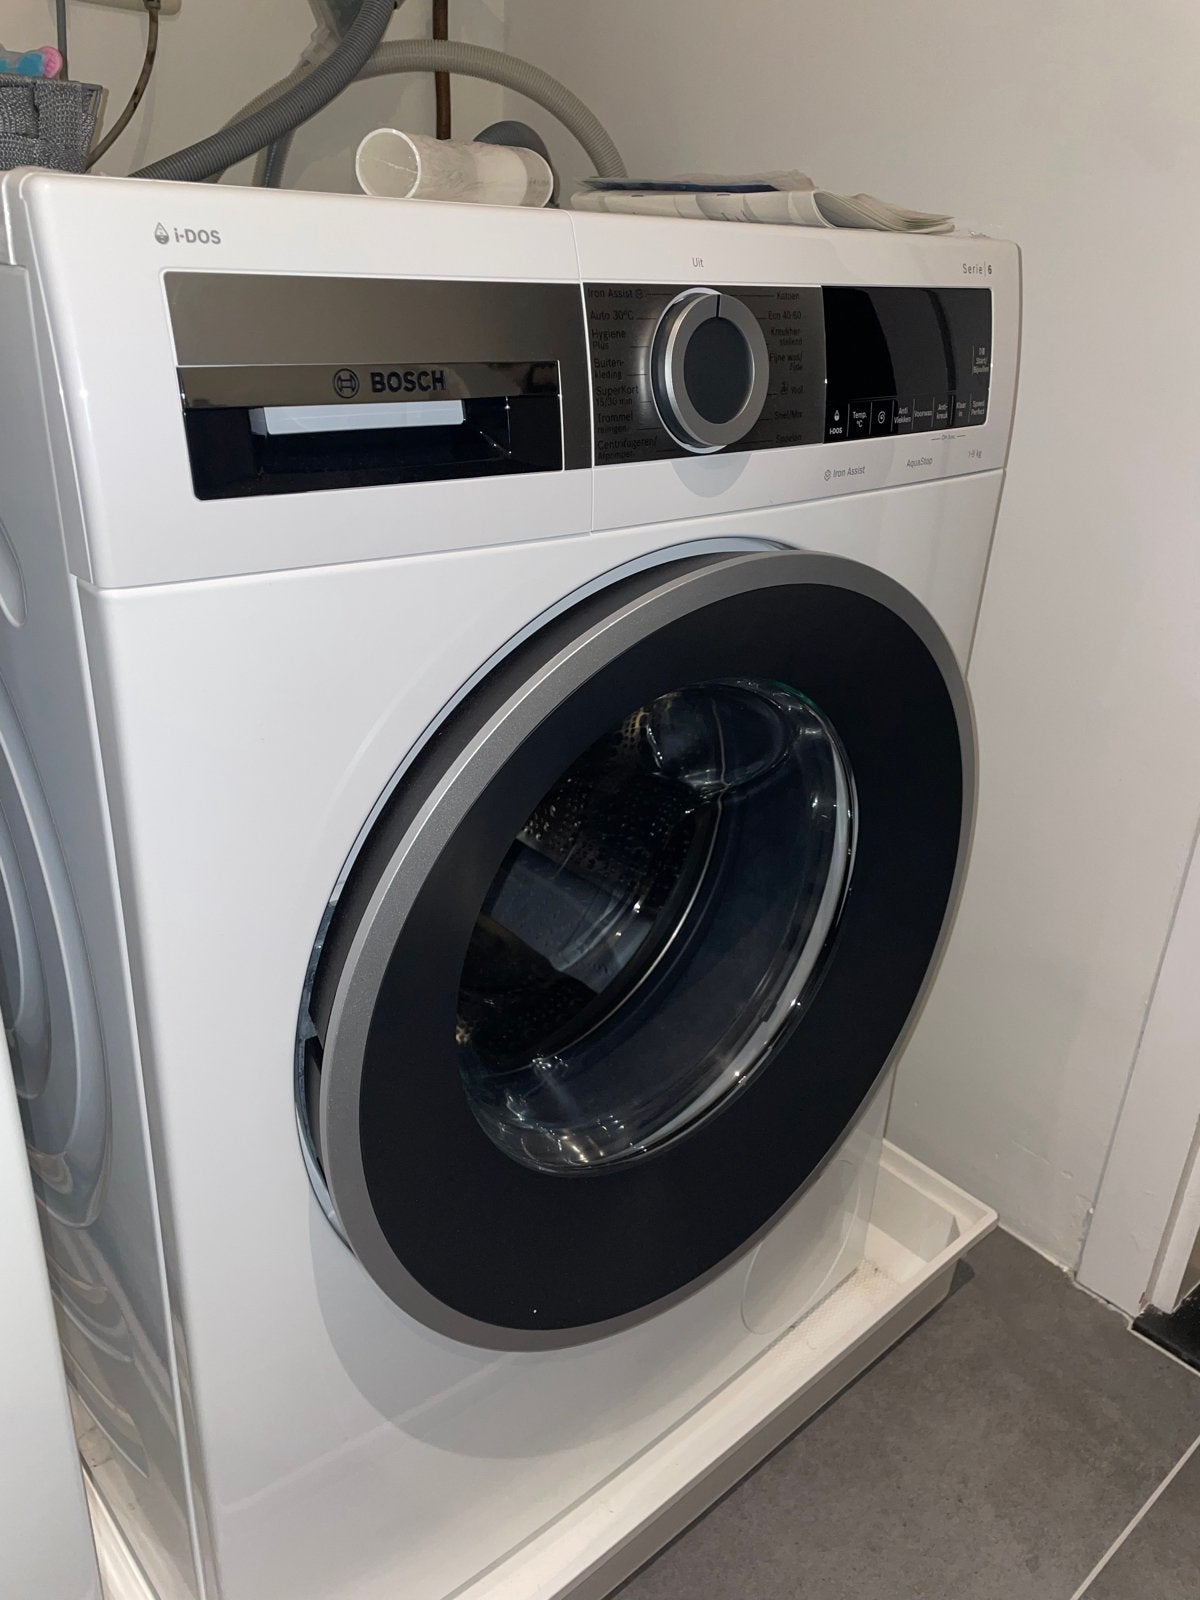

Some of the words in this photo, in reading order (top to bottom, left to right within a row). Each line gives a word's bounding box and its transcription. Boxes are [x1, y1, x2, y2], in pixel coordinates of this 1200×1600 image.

[174, 227, 221, 245] i-DOS
[692, 256, 705, 268] Uit
[587, 288, 605, 298] Iron
[608, 288, 633, 299] Assist
[590, 310, 611, 321] Auto
[591, 328, 626, 342] Hygiene
[592, 341, 610, 350] Plus
[370, 370, 446, 393] BOSCH
[595, 385, 639, 398] SuperKort
[597, 411, 633, 424] Trommel
[852, 411, 868, 420] Temp.
[906, 456, 933, 468] AquaStop
[832, 469, 846, 478] Iron
[846, 465, 866, 476] Assist
